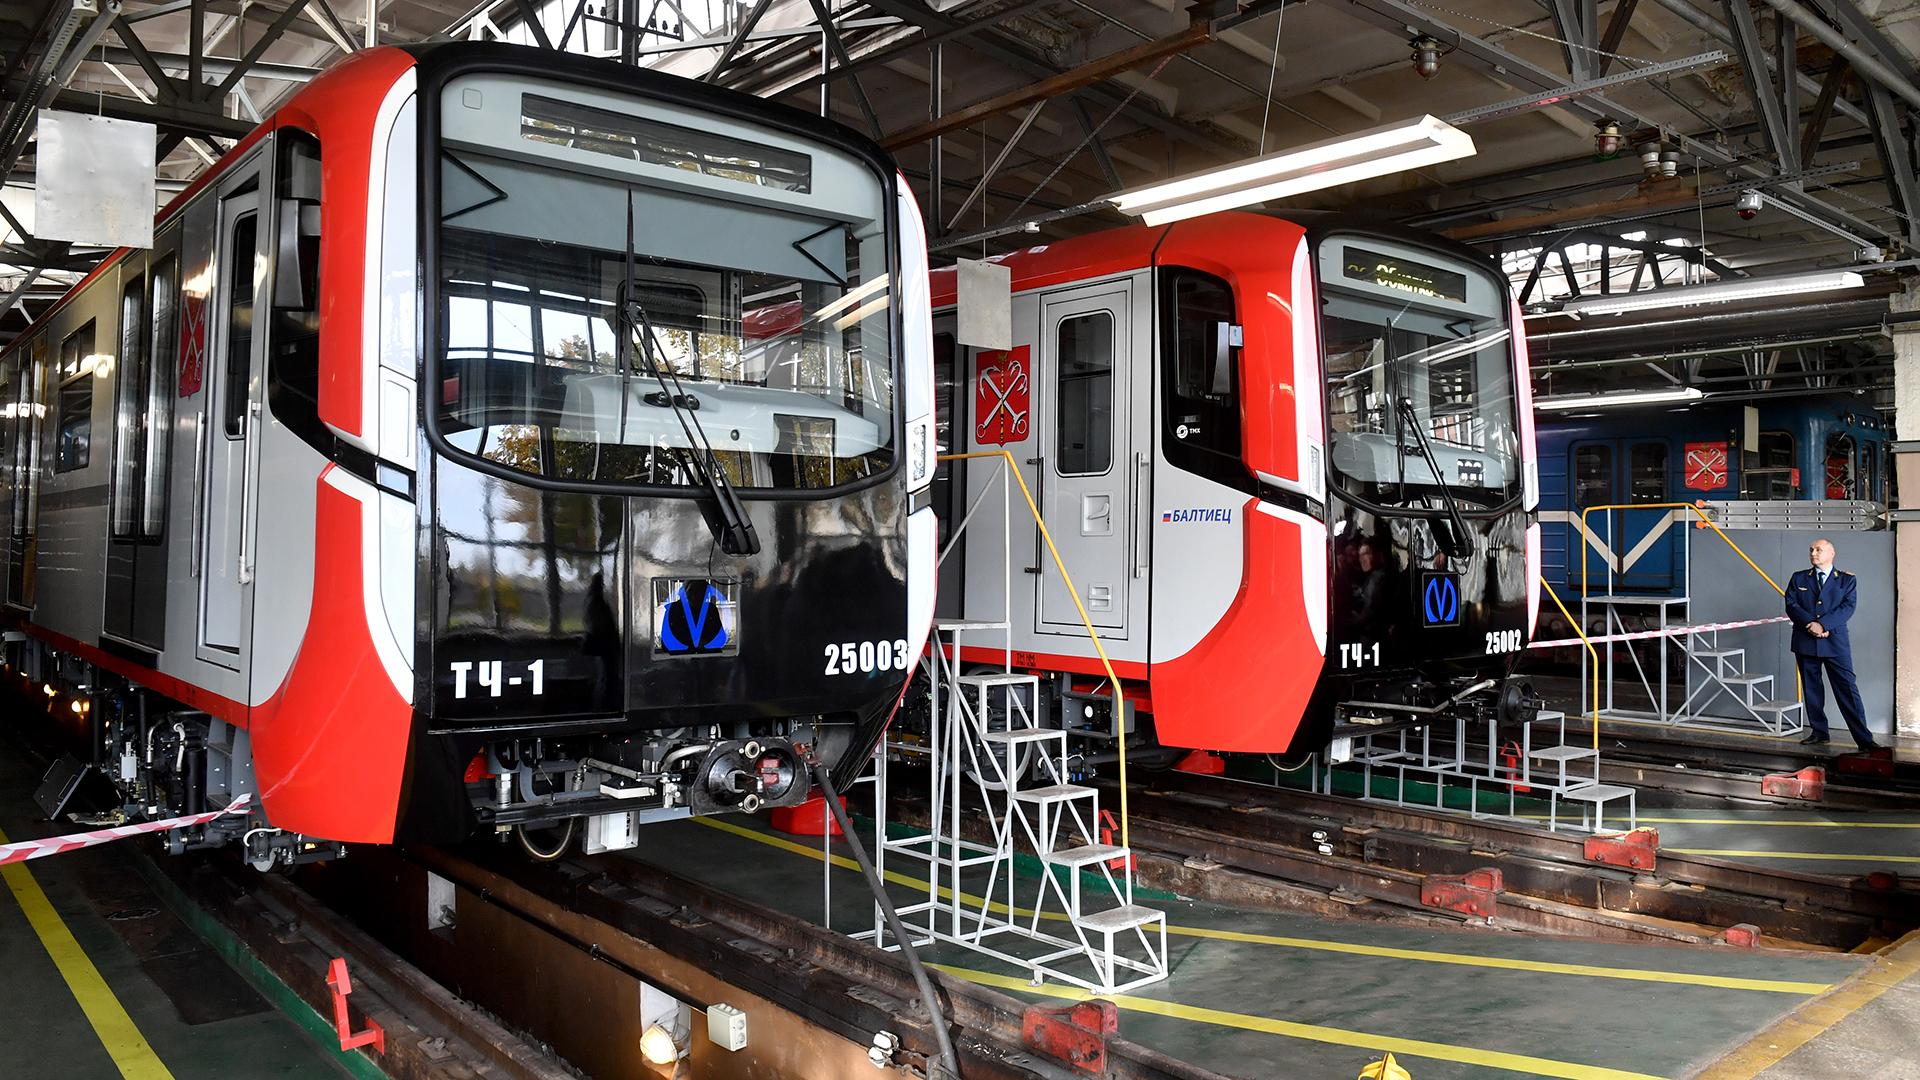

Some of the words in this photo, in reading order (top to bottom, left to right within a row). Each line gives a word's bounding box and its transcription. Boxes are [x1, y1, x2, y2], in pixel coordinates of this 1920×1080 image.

[1172, 508, 1232, 525] БАЛТИЕЦ
[1340, 642, 1380, 669] ТЧ-1
[1485, 629, 1522, 655] 25002
[824, 639, 909, 676] 25003
[450, 659, 544, 699] ТЧ-1
